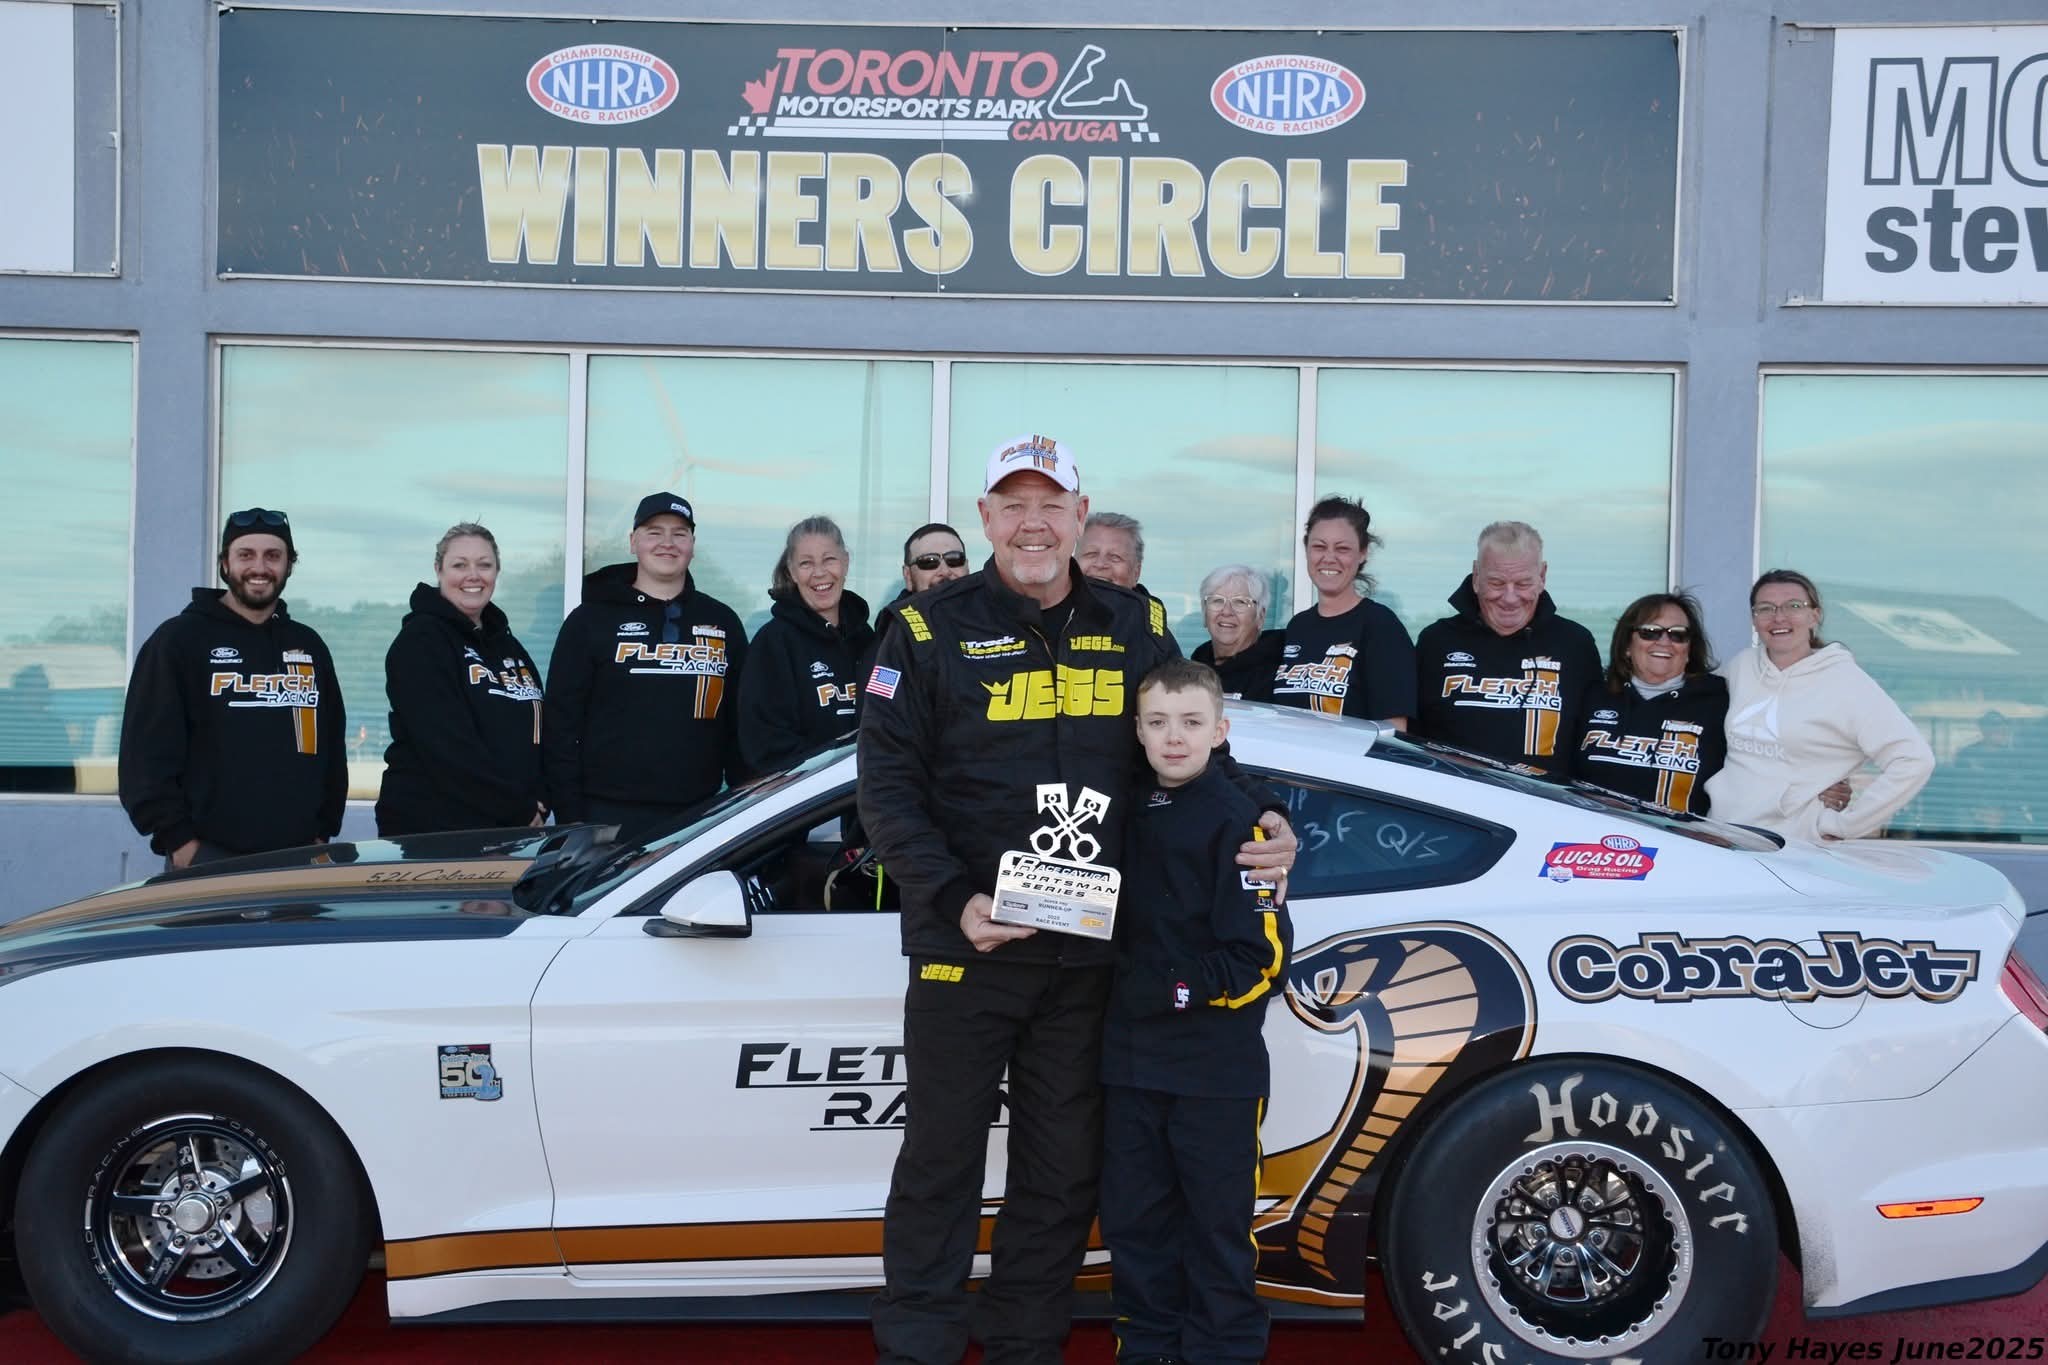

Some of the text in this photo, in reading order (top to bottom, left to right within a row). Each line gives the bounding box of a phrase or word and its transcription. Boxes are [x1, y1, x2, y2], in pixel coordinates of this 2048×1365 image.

[553, 48, 652, 64] CHAMPIONSHIP
[776, 48, 1059, 97] TORONTO
[1237, 59, 1338, 75] CHAMPIONSHIP
[553, 61, 656, 108] NHRA
[1237, 71, 1341, 119] NHRA
[553, 101, 649, 121] DRAG RACING
[777, 96, 1048, 119] MOTORSPORTS PARK
[1012, 121, 1119, 142] CAYUGA
[1238, 115, 1334, 132] DRAG RACING
[477, 143, 1408, 280] WINNERS CIRCLE
[900, 604, 933, 642] JEGS
[615, 642, 725, 663] FLETCH
[965, 635, 1016, 650] Track
[968, 640, 1026, 655] Tested
[665, 661, 727, 675] RACING
[1274, 663, 1350, 683] LETCH
[210, 671, 316, 696] FLETCH
[980, 663, 1124, 722] JEGS
[1441, 675, 1559, 697] FLETCH
[260, 691, 319, 705] RACING
[816, 683, 857, 707] FLE
[1496, 695, 1562, 711] RACING
[1580, 730, 1698, 759] FLETCH
[1606, 836, 1636, 850] NHRA
[1551, 850, 1643, 867] LUCAS OIL
[1576, 865, 1601, 873] Drag
[1603, 866, 1639, 874] Racing
[1001, 869, 1118, 895] SPORTSMAN
[1021, 881, 1086, 898] SERIES
[1038, 903, 1073, 912] RUNNER-UP
[920, 963, 965, 982] JEGS
[736, 1042, 907, 1089] FLET
[87, 1127, 146, 1198] RACING
[1523, 1072, 1749, 1234] Hoosier
